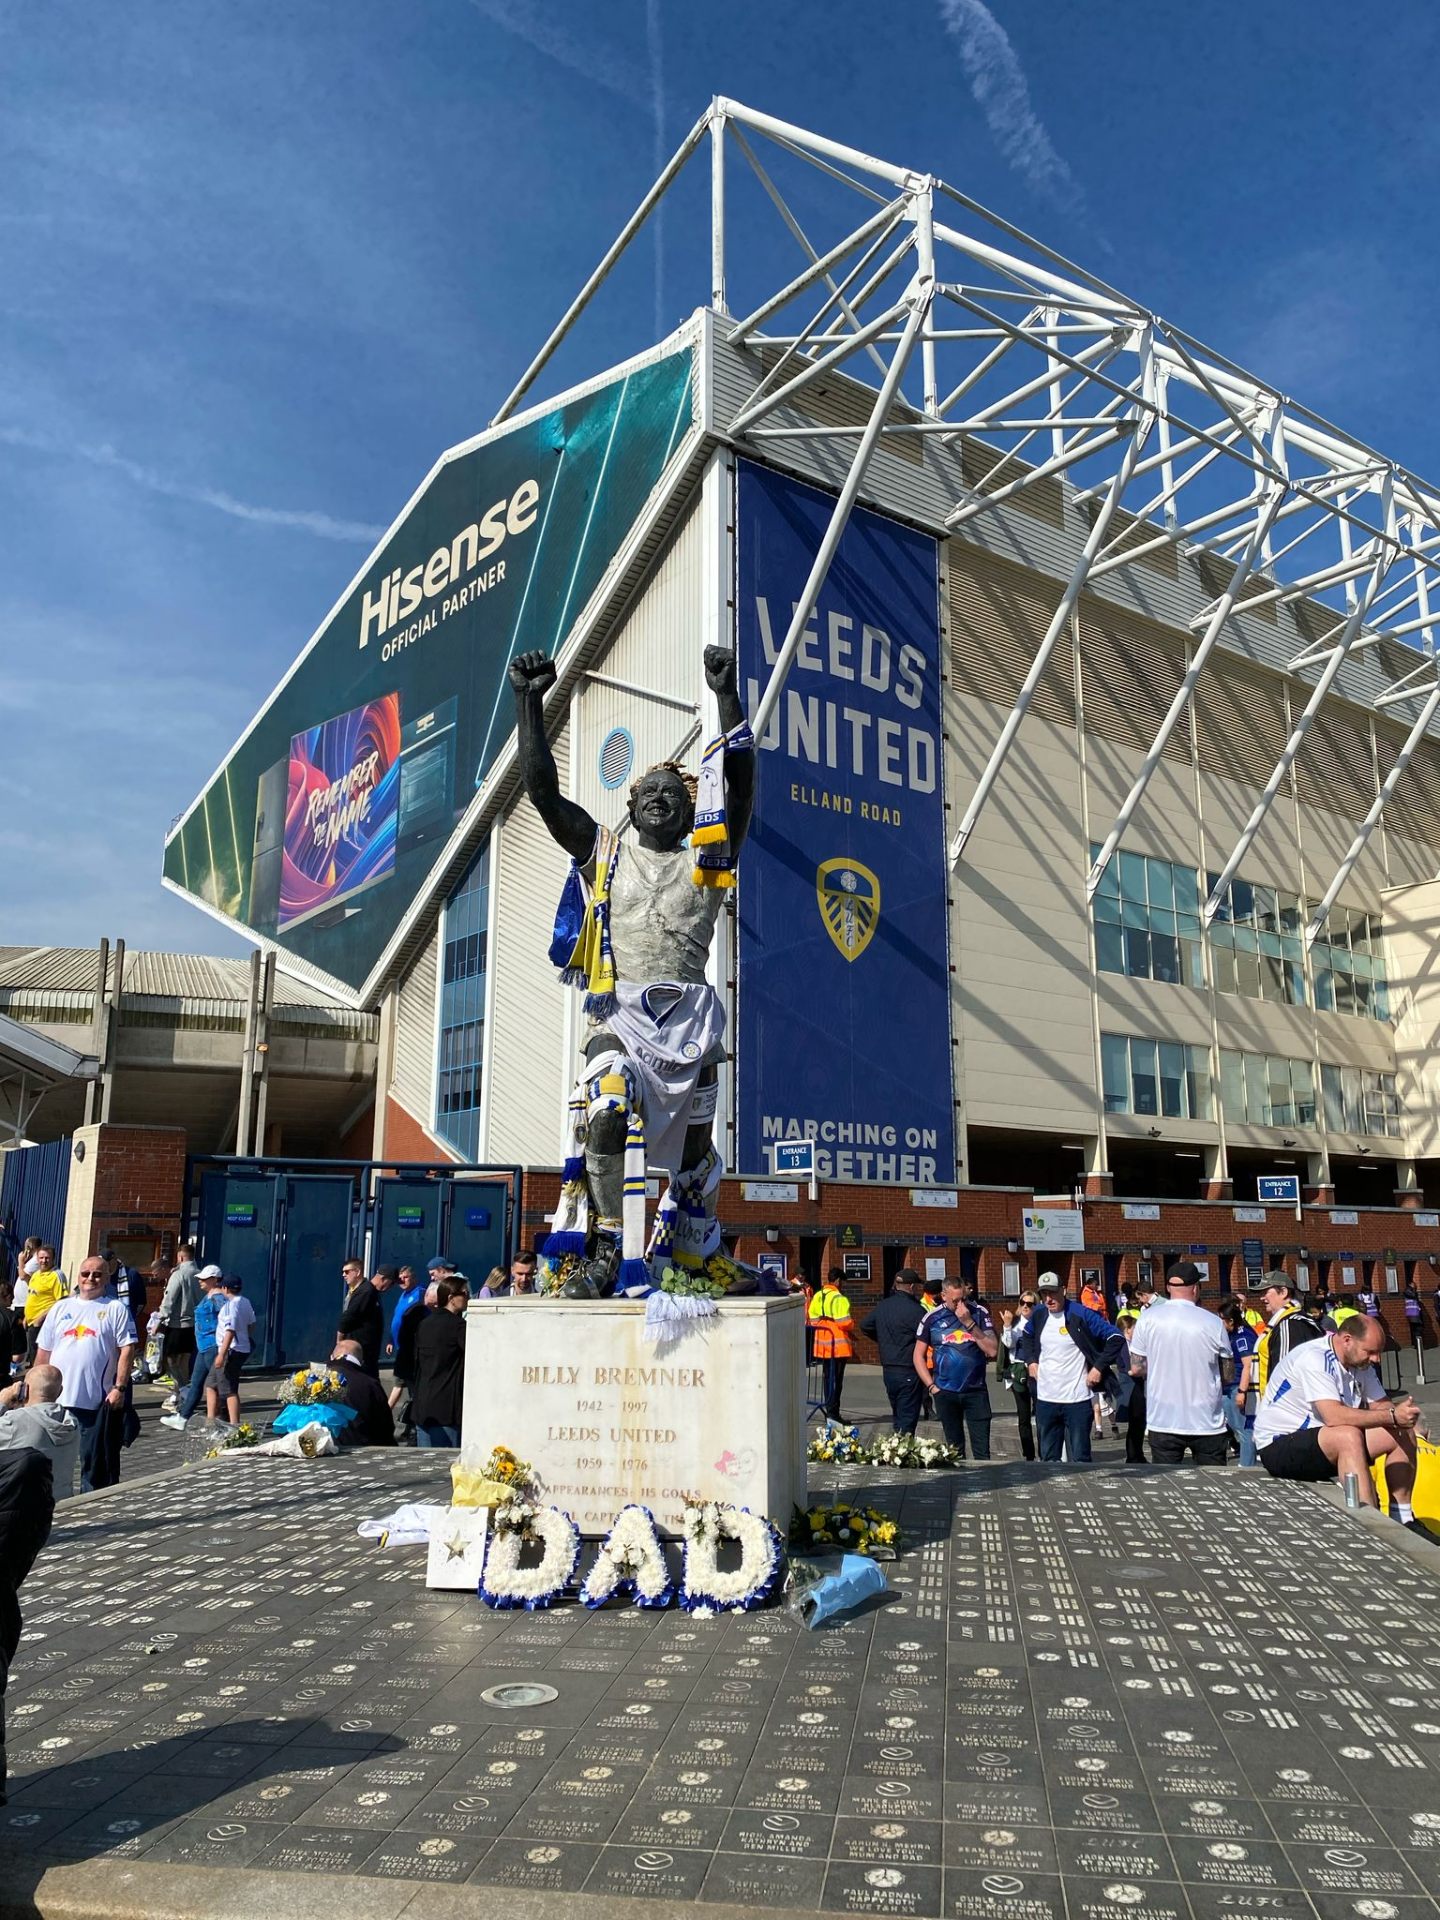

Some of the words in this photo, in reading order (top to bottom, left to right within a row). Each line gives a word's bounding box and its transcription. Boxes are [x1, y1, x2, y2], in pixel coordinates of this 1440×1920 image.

[359, 479, 539, 650] Hisense
[382, 609, 437, 661] OFFICIAL
[442, 560, 506, 621] PARTNER
[756, 596, 926, 710] LEEDS
[747, 677, 937, 794] UNITED
[305, 751, 378, 826] REMEMBER
[790, 783, 852, 814] ELLAND
[861, 803, 901, 827] ROAD
[762, 1116, 896, 1147] MARCHING
[905, 1127, 937, 1149] ON
[783, 1147, 807, 1155] ENTRANCE
[762, 1146, 937, 1184] TGETHER
[790, 1156, 800, 1167] 13
[1274, 1187, 1283, 1196] 12
[522, 1366, 580, 1386] BILLY
[595, 1367, 706, 1388] BREMNER
[577, 1400, 602, 1412] 1942
[622, 1401, 648, 1413] 1997
[548, 1427, 600, 1442] LEEDS
[610, 1428, 677, 1443] UNITED
[576, 1458, 602, 1470] 1959
[622, 1459, 648, 1471] 1976
[789, 1839, 810, 1847] AND
[842, 1888, 869, 1896] PAUL
[849, 1895, 883, 1903] HAPPY
[1214, 1894, 1285, 1907] LUFC
[845, 1902, 871, 1910] LOVE
[1081, 1904, 1124, 1914] DANIEL
